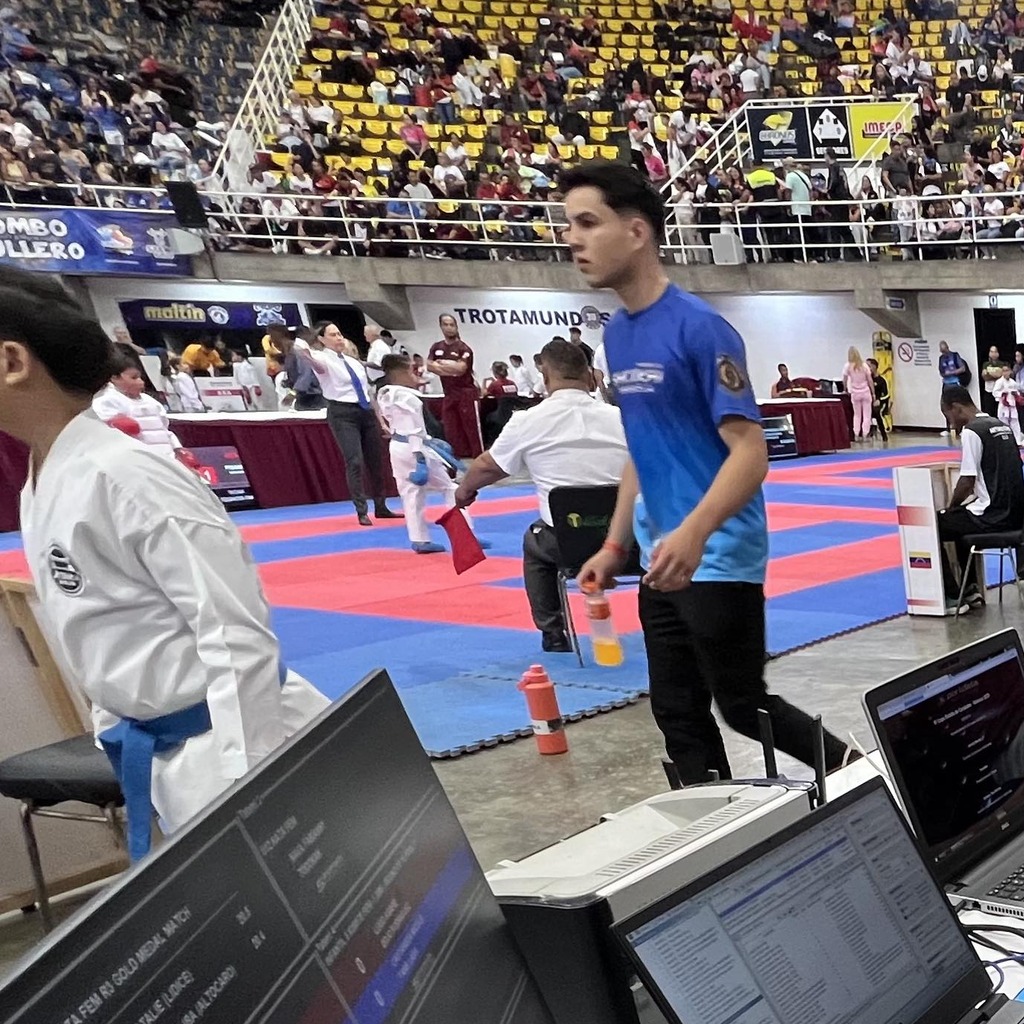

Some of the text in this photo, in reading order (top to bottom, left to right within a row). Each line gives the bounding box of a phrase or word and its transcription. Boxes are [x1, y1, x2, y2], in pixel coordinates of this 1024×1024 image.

[0, 217, 68, 237] MBO
[143, 303, 206, 322] maltin
[78, 993, 102, 1017] FEM
[112, 957, 138, 985] GOLD
[135, 933, 166, 963] MEDAL
[162, 907, 190, 936] MATCH
